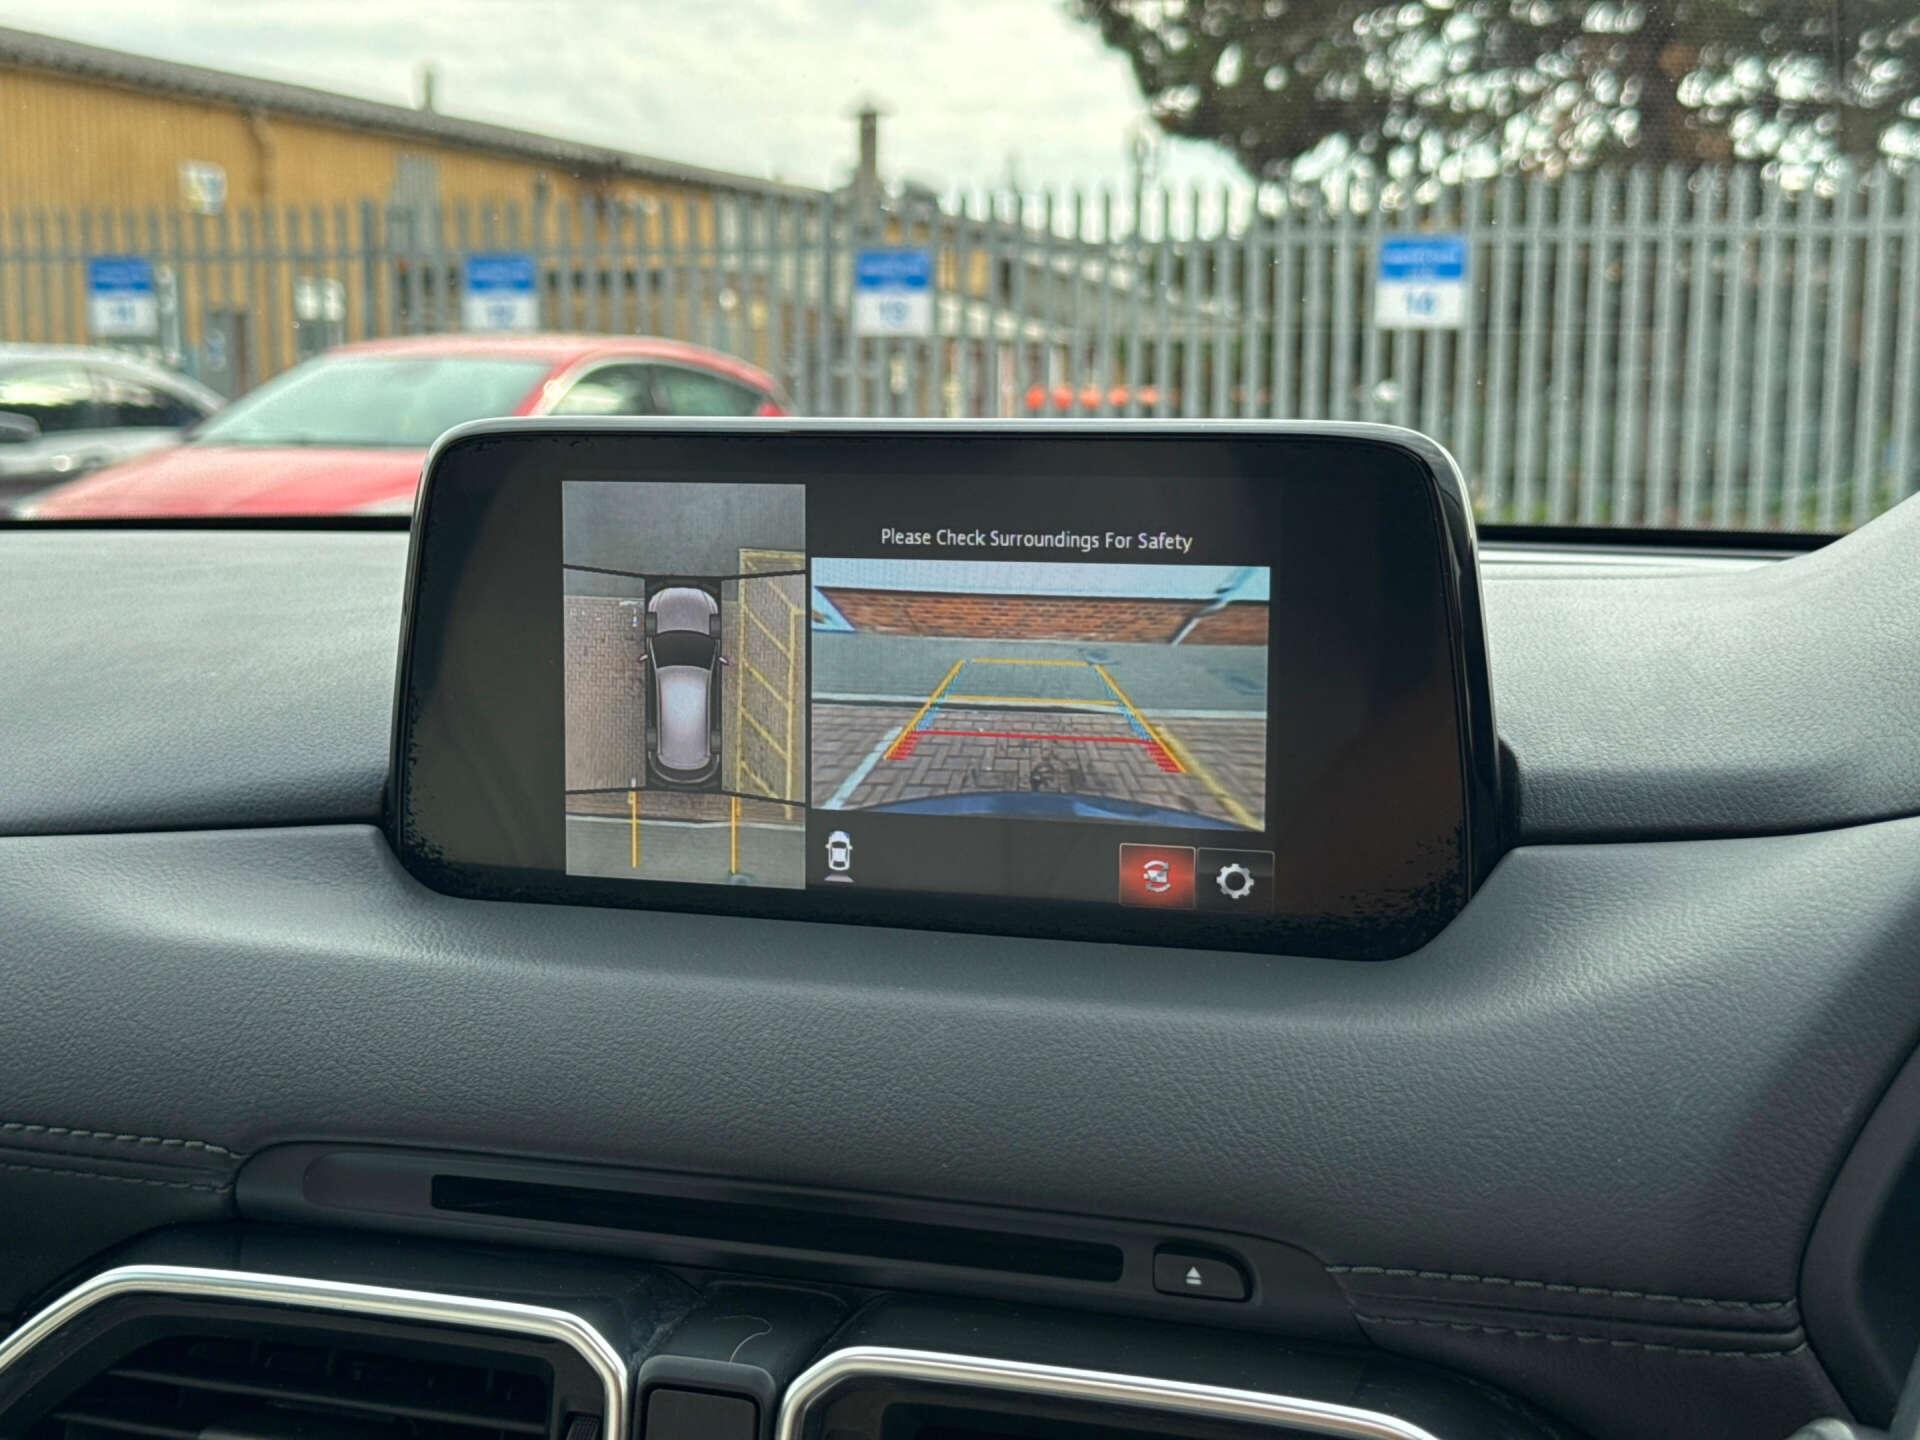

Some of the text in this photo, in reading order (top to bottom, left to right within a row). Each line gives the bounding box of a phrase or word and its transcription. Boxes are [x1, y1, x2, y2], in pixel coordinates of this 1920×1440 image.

[881, 528, 1193, 553] Please Check Surroundings For Safety
